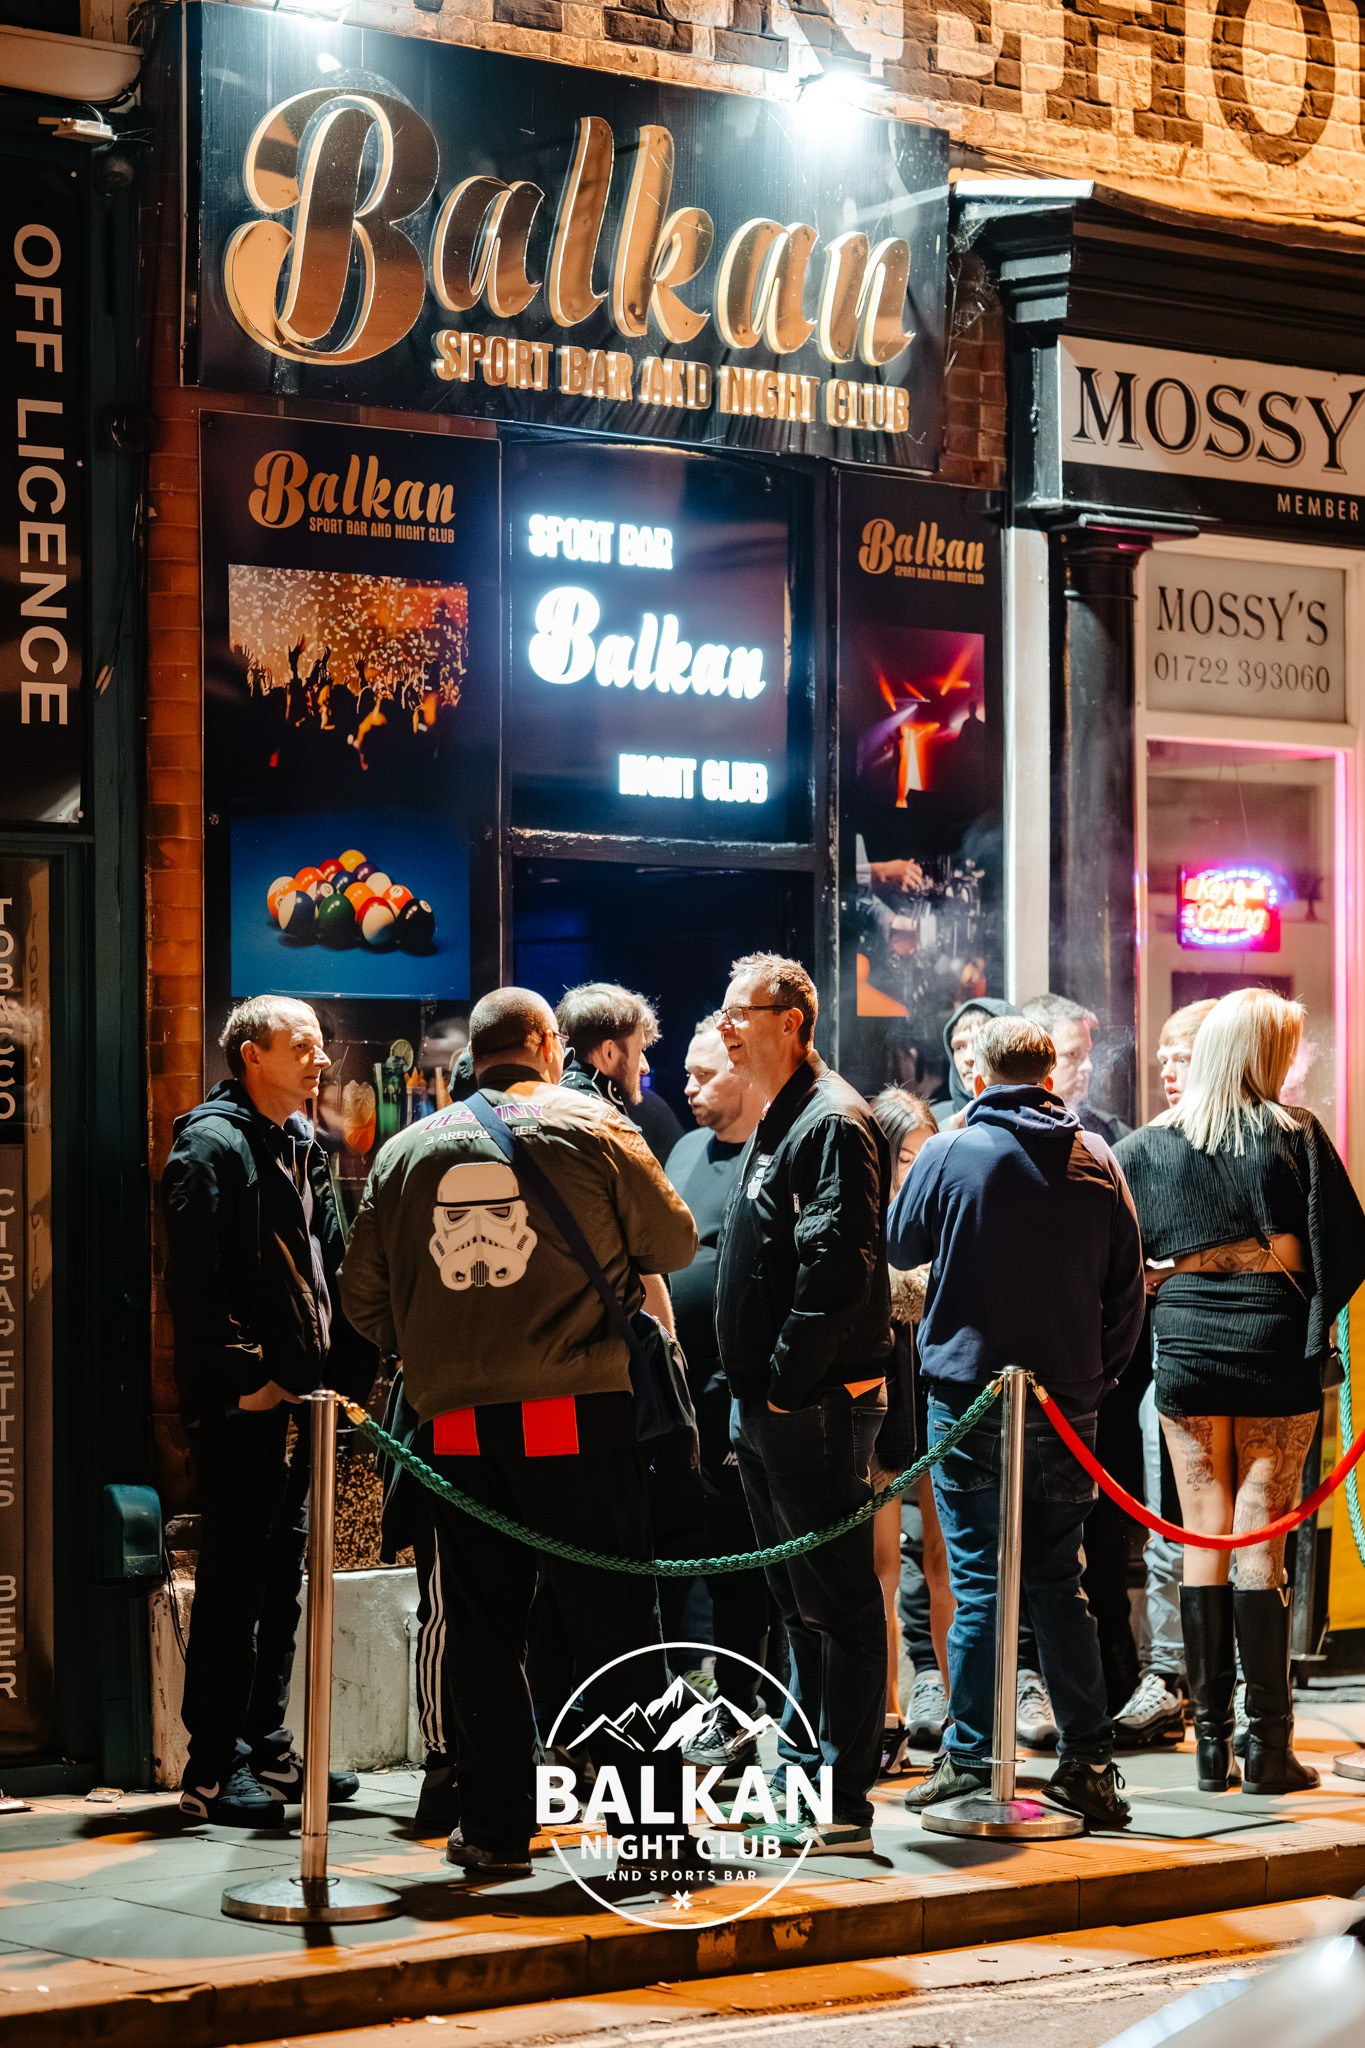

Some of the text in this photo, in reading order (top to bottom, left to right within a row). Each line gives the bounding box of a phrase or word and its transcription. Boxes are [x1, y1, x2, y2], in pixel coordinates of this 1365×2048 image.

[223, 86, 917, 367] Balkan
[434, 330, 911, 433] SPORT BAR AND NIGHT CLUB
[1069, 365, 1365, 477] MOSSY
[13, 223, 69, 726] OFF LICENCE
[248, 450, 456, 529] Balkan
[309, 516, 456, 544] SPORT BAR AND NIGHT CLUB
[1276, 493, 1360, 522] MEMBER
[528, 513, 674, 571] SPORT BAR
[858, 518, 985, 575] Balkan
[528, 586, 767, 699] Balkan
[1156, 583, 1329, 647] MOSSY'S
[1154, 652, 1331, 694] 01722 393060
[701, 759, 769, 804] CLUB
[1197, 876, 1234, 907] Key
